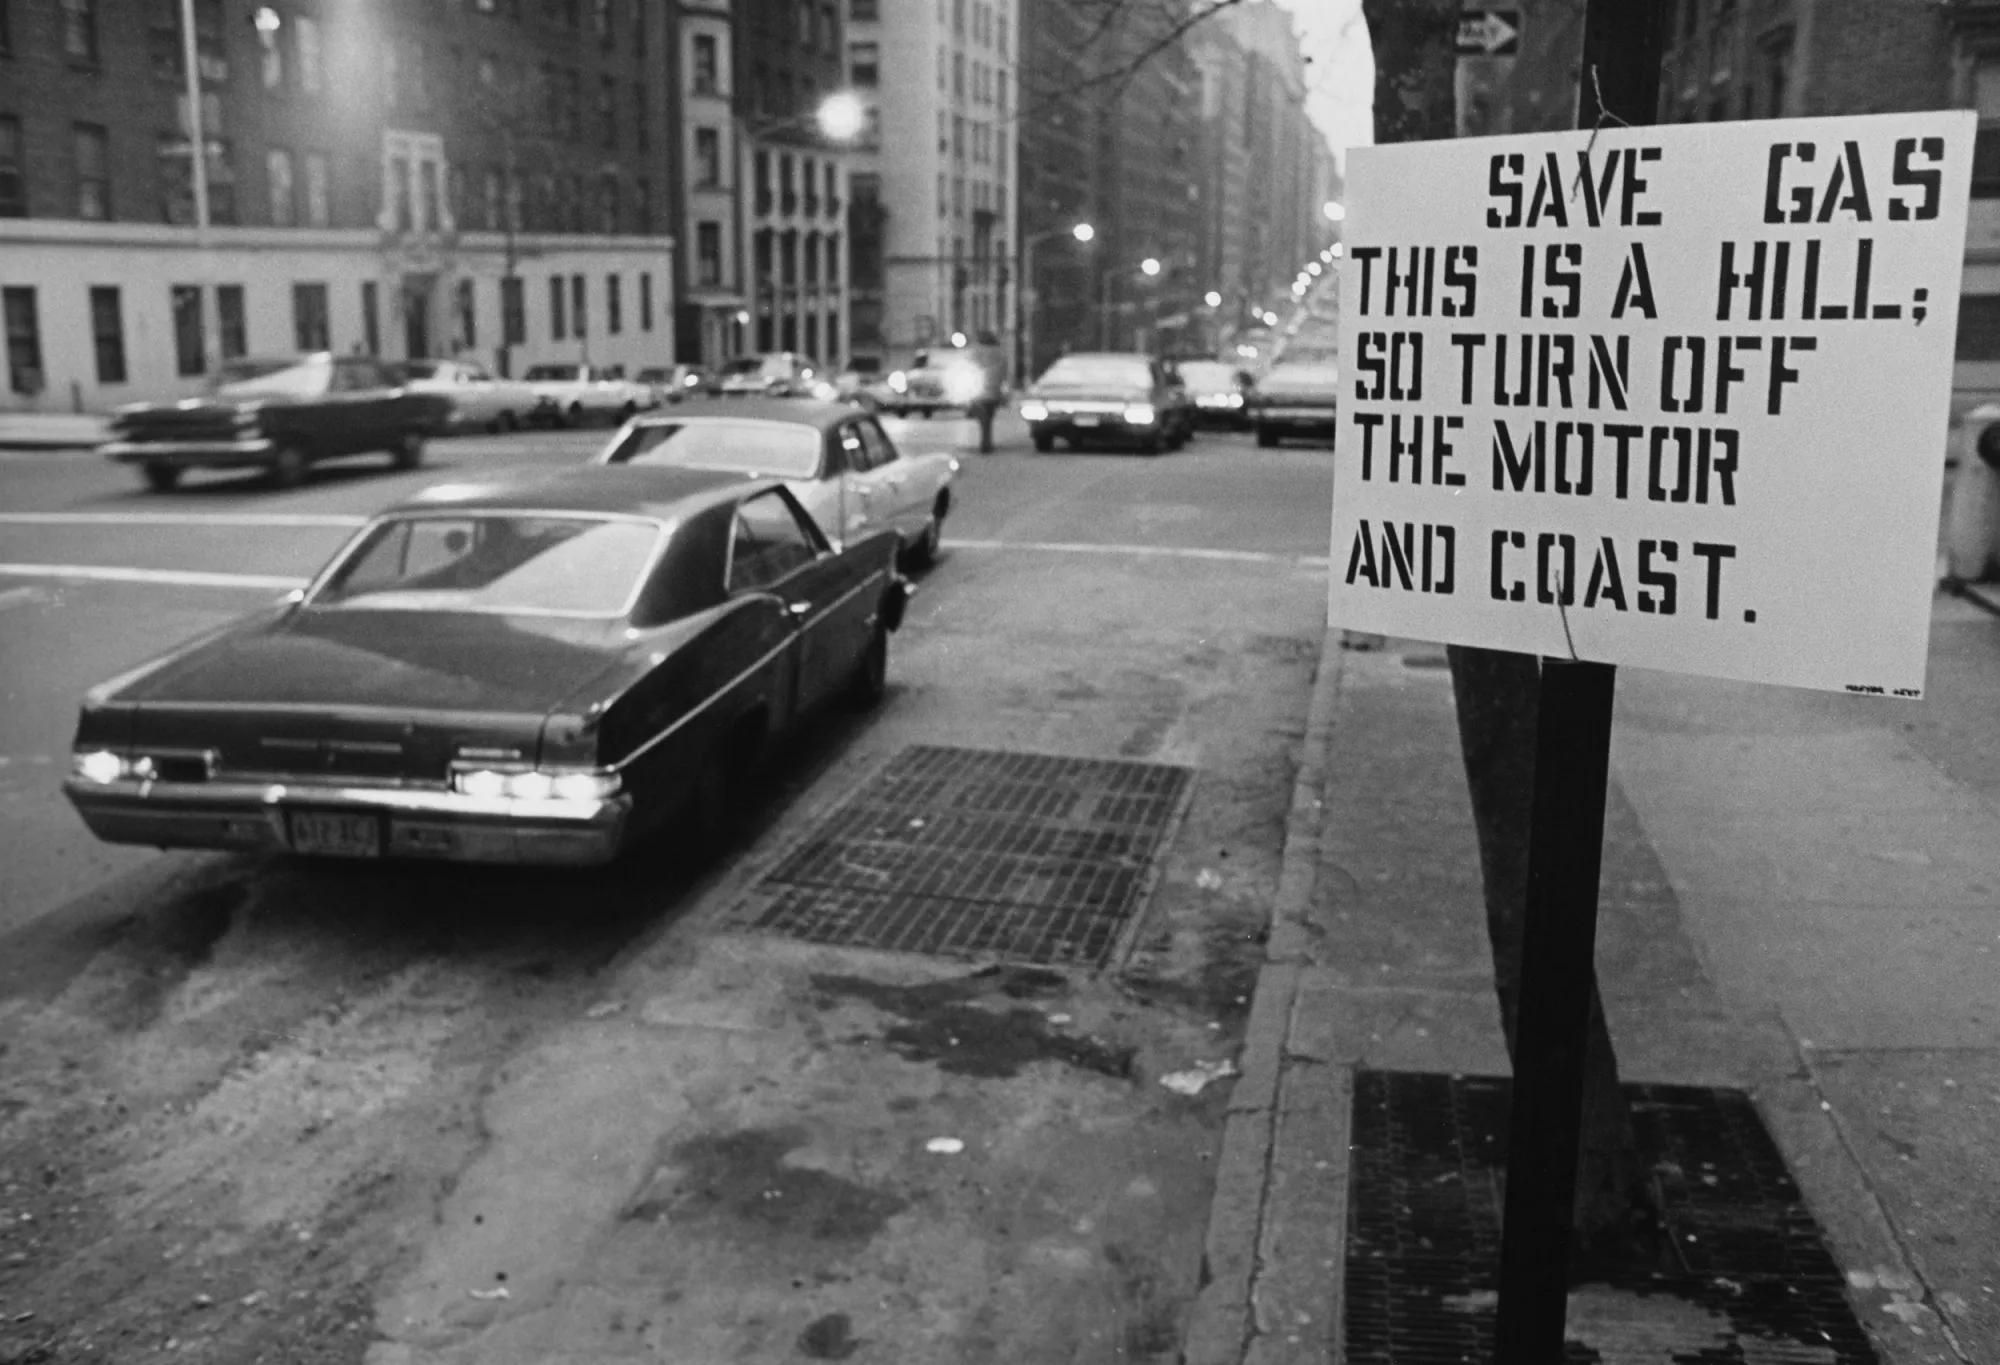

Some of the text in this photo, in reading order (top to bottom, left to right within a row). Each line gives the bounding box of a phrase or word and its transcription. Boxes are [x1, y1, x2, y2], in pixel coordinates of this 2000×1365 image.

[1487, 138, 1944, 229] SAVE GAS
[1352, 239, 1928, 325] THIS IS A HILL;
[1356, 332, 1817, 415] SO TURN OFF
[1354, 413, 1739, 506] THE MOTOR
[1346, 520, 1756, 623] AND COAST.
